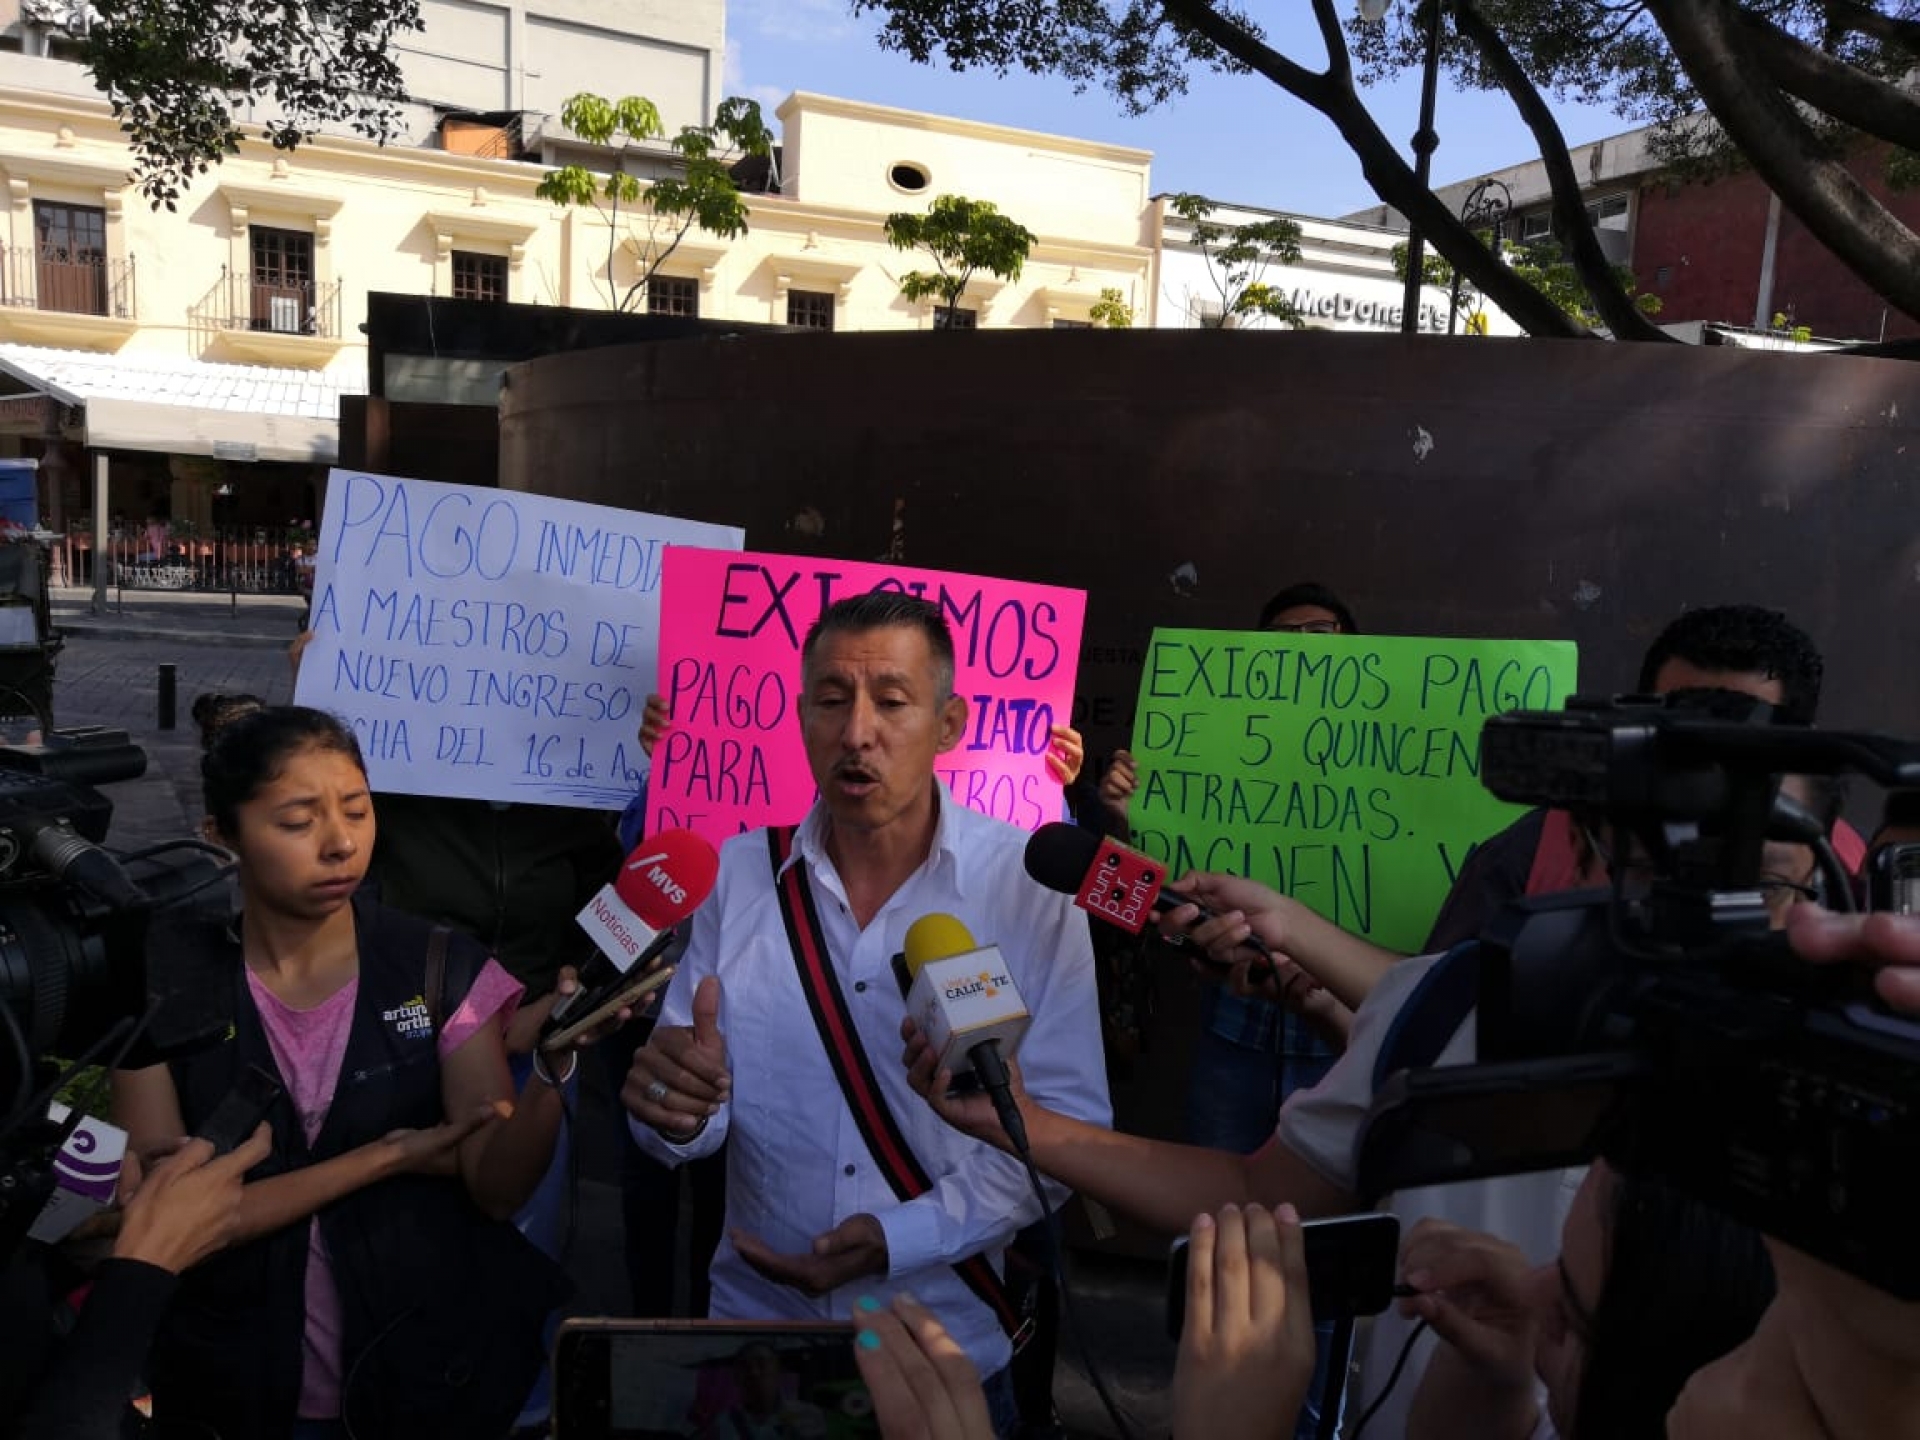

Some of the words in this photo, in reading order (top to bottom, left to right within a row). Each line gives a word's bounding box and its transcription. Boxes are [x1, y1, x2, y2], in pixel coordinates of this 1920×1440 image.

[1293, 287, 1449, 331] McDonad's
[335, 477, 519, 581] PAGO
[313, 583, 342, 634] A
[361, 588, 568, 658] MAESTROS
[590, 620, 640, 669] DE
[334, 649, 448, 703] NUEVO
[460, 668, 631, 722] INGRESO
[670, 658, 786, 731] PAGO
[1150, 642, 1390, 711] EXIGIMOS
[1421, 654, 1551, 717] PAGO
[436, 725, 494, 766] DEL
[523, 733, 561, 778] 16
[566, 738, 594, 779] de
[662, 731, 771, 806] PARA
[1144, 711, 1205, 758] DE
[1239, 714, 1272, 766] 5
[1304, 716, 1482, 779] QUINCEN
[1143, 769, 1414, 841] ATRAZADAS.
[647, 865, 687, 904] MVS
[590, 897, 639, 956] Noticias
